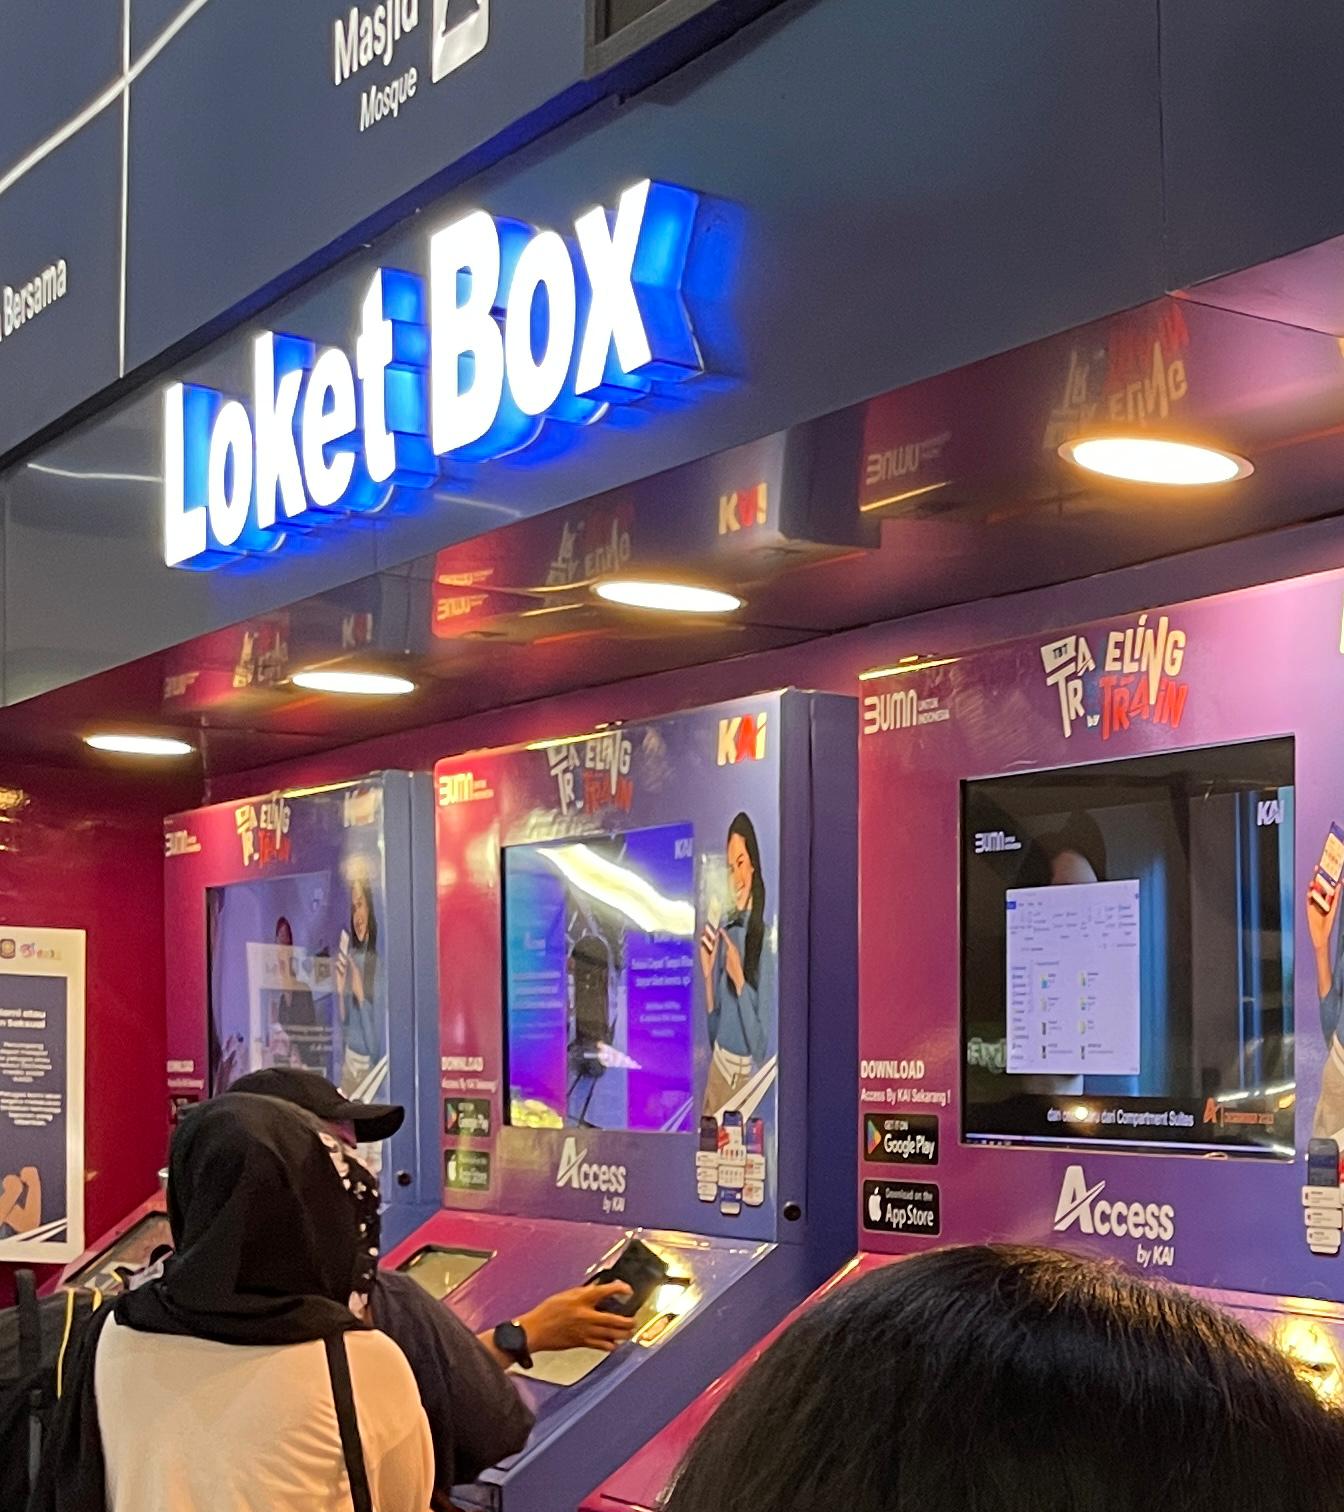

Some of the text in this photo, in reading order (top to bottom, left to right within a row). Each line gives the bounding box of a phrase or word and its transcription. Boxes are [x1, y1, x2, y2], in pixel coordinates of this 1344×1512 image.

[360, 67, 418, 132] Mosque
[3, 259, 67, 336] Bersama
[163, 178, 652, 568] Loket Box
[717, 711, 768, 767] KAI
[860, 1060, 925, 1080] DOWNLOAD
[556, 1136, 627, 1194] Access
[884, 1133, 936, 1160] Google Play
[885, 1202, 934, 1229] App Store
[1053, 1165, 1175, 1241] Access
[1136, 1244, 1175, 1268] by KAI
